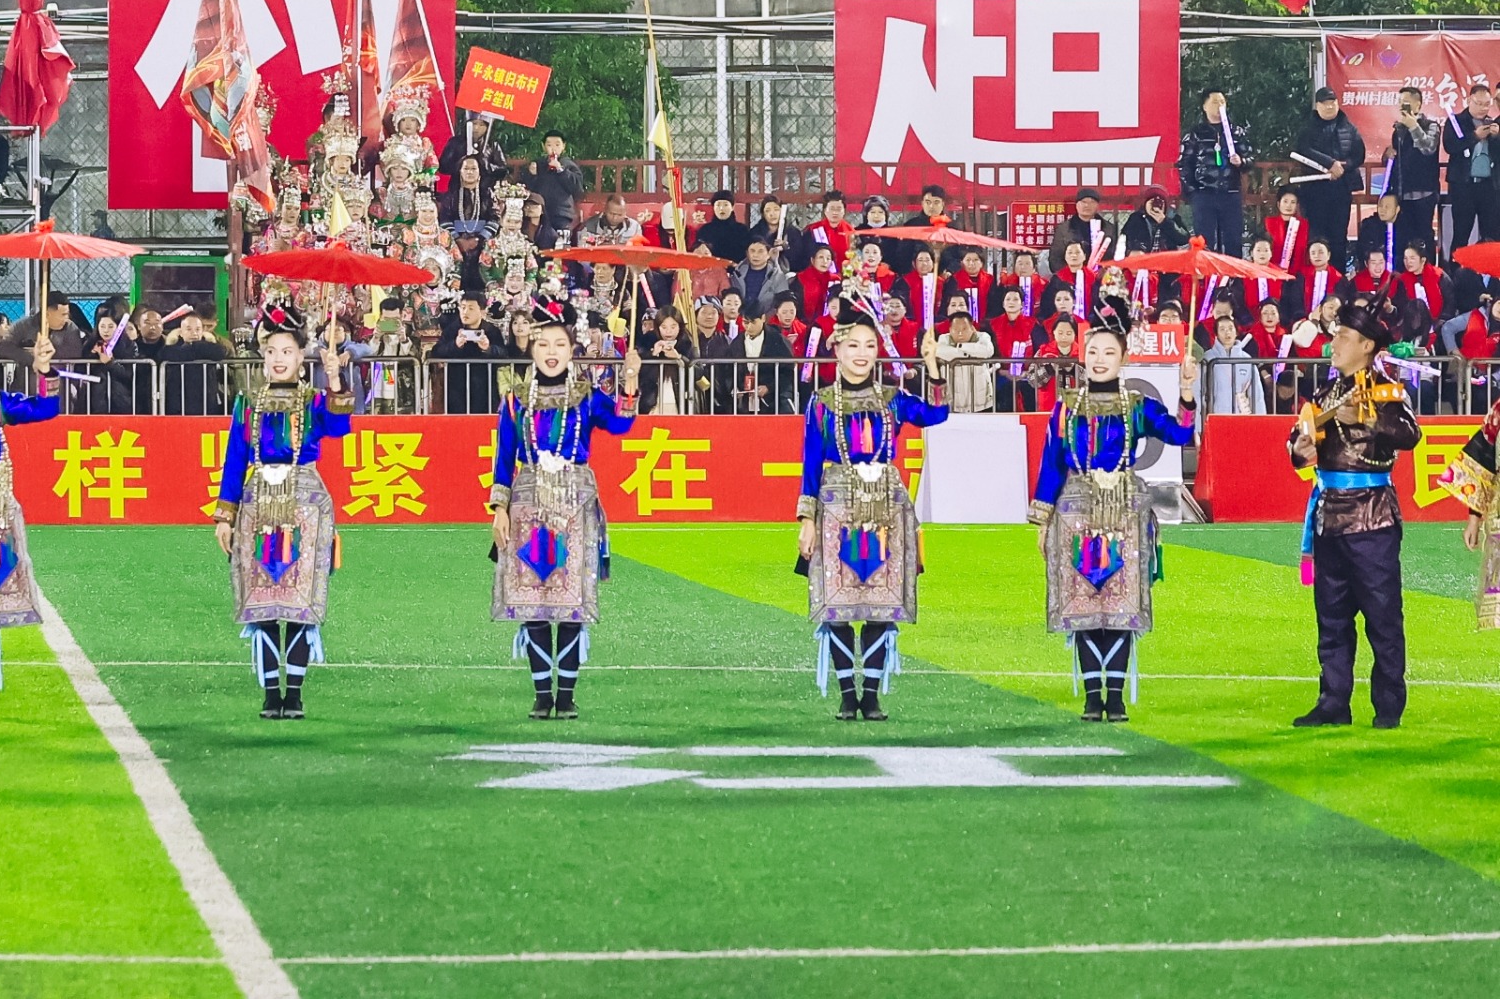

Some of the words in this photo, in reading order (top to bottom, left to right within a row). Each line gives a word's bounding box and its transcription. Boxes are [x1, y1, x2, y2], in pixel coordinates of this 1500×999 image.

[1404, 76, 1435, 89] 2024
[481, 87, 515, 111] 芦笙队
